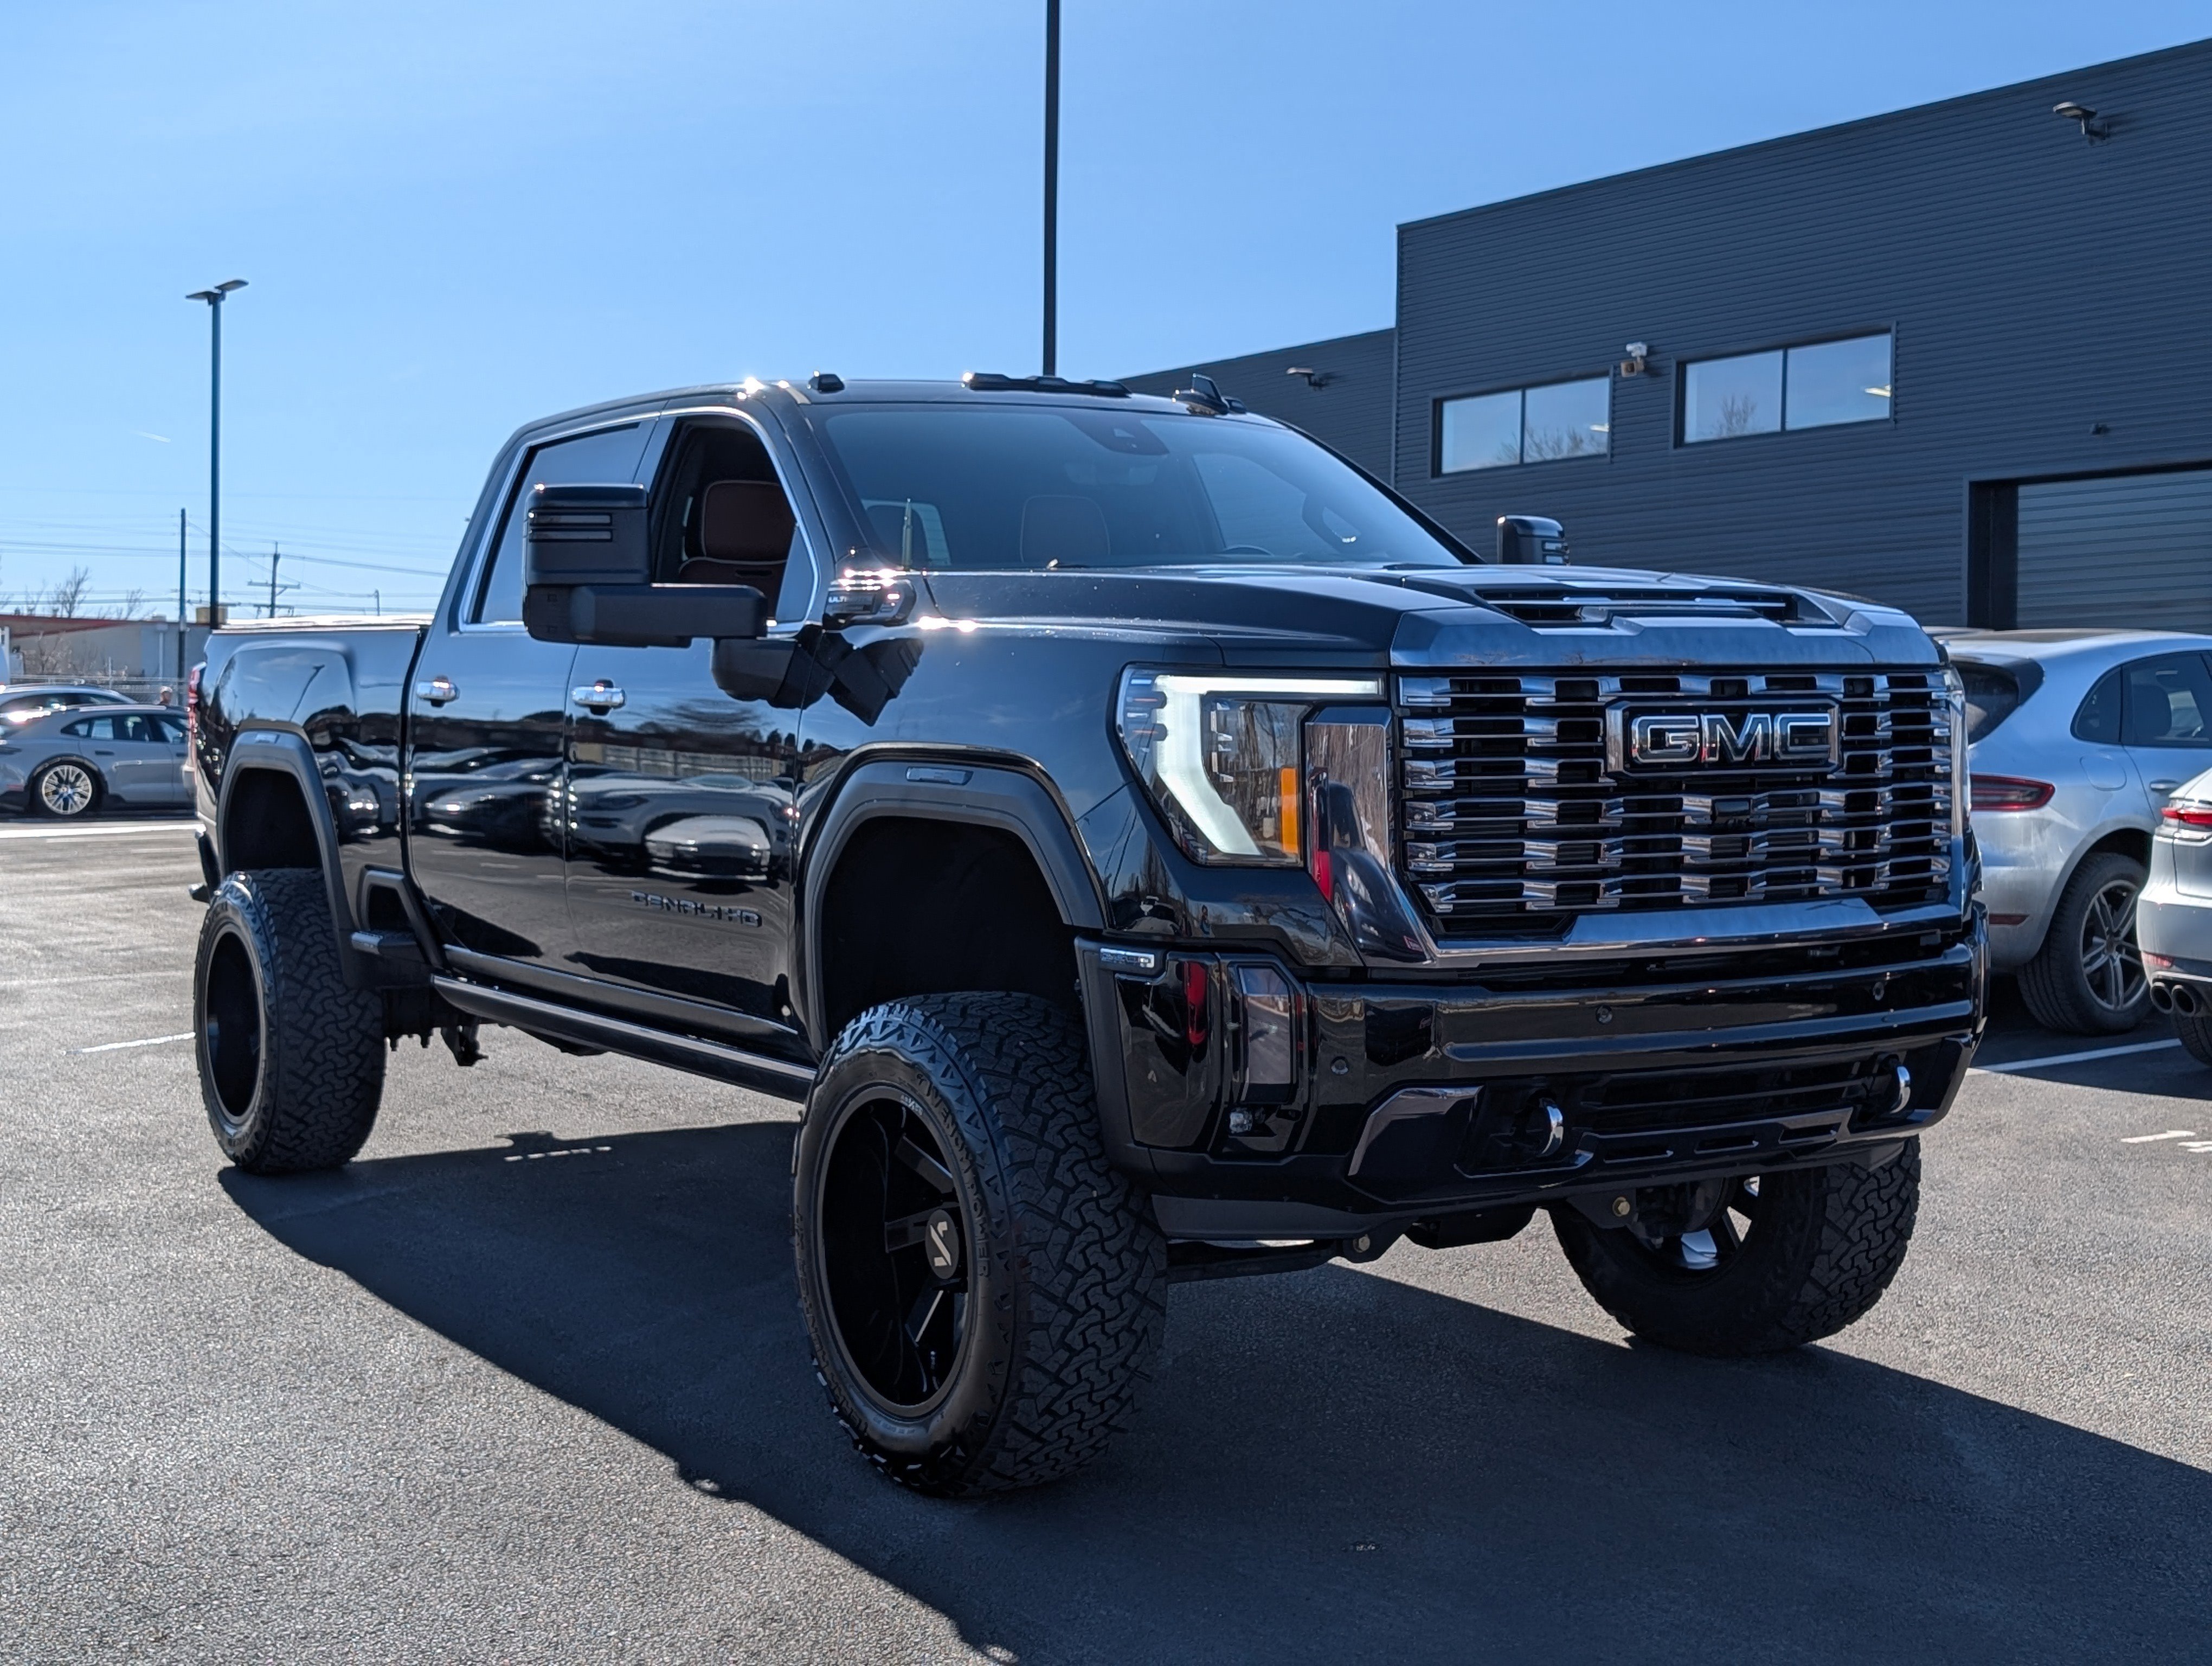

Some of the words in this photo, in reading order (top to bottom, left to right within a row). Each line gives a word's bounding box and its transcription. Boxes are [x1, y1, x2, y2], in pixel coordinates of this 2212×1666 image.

[1631, 713, 1831, 762] GMC
[927, 1082, 975, 1174] VENOM
[966, 1176, 991, 1279] POWER
